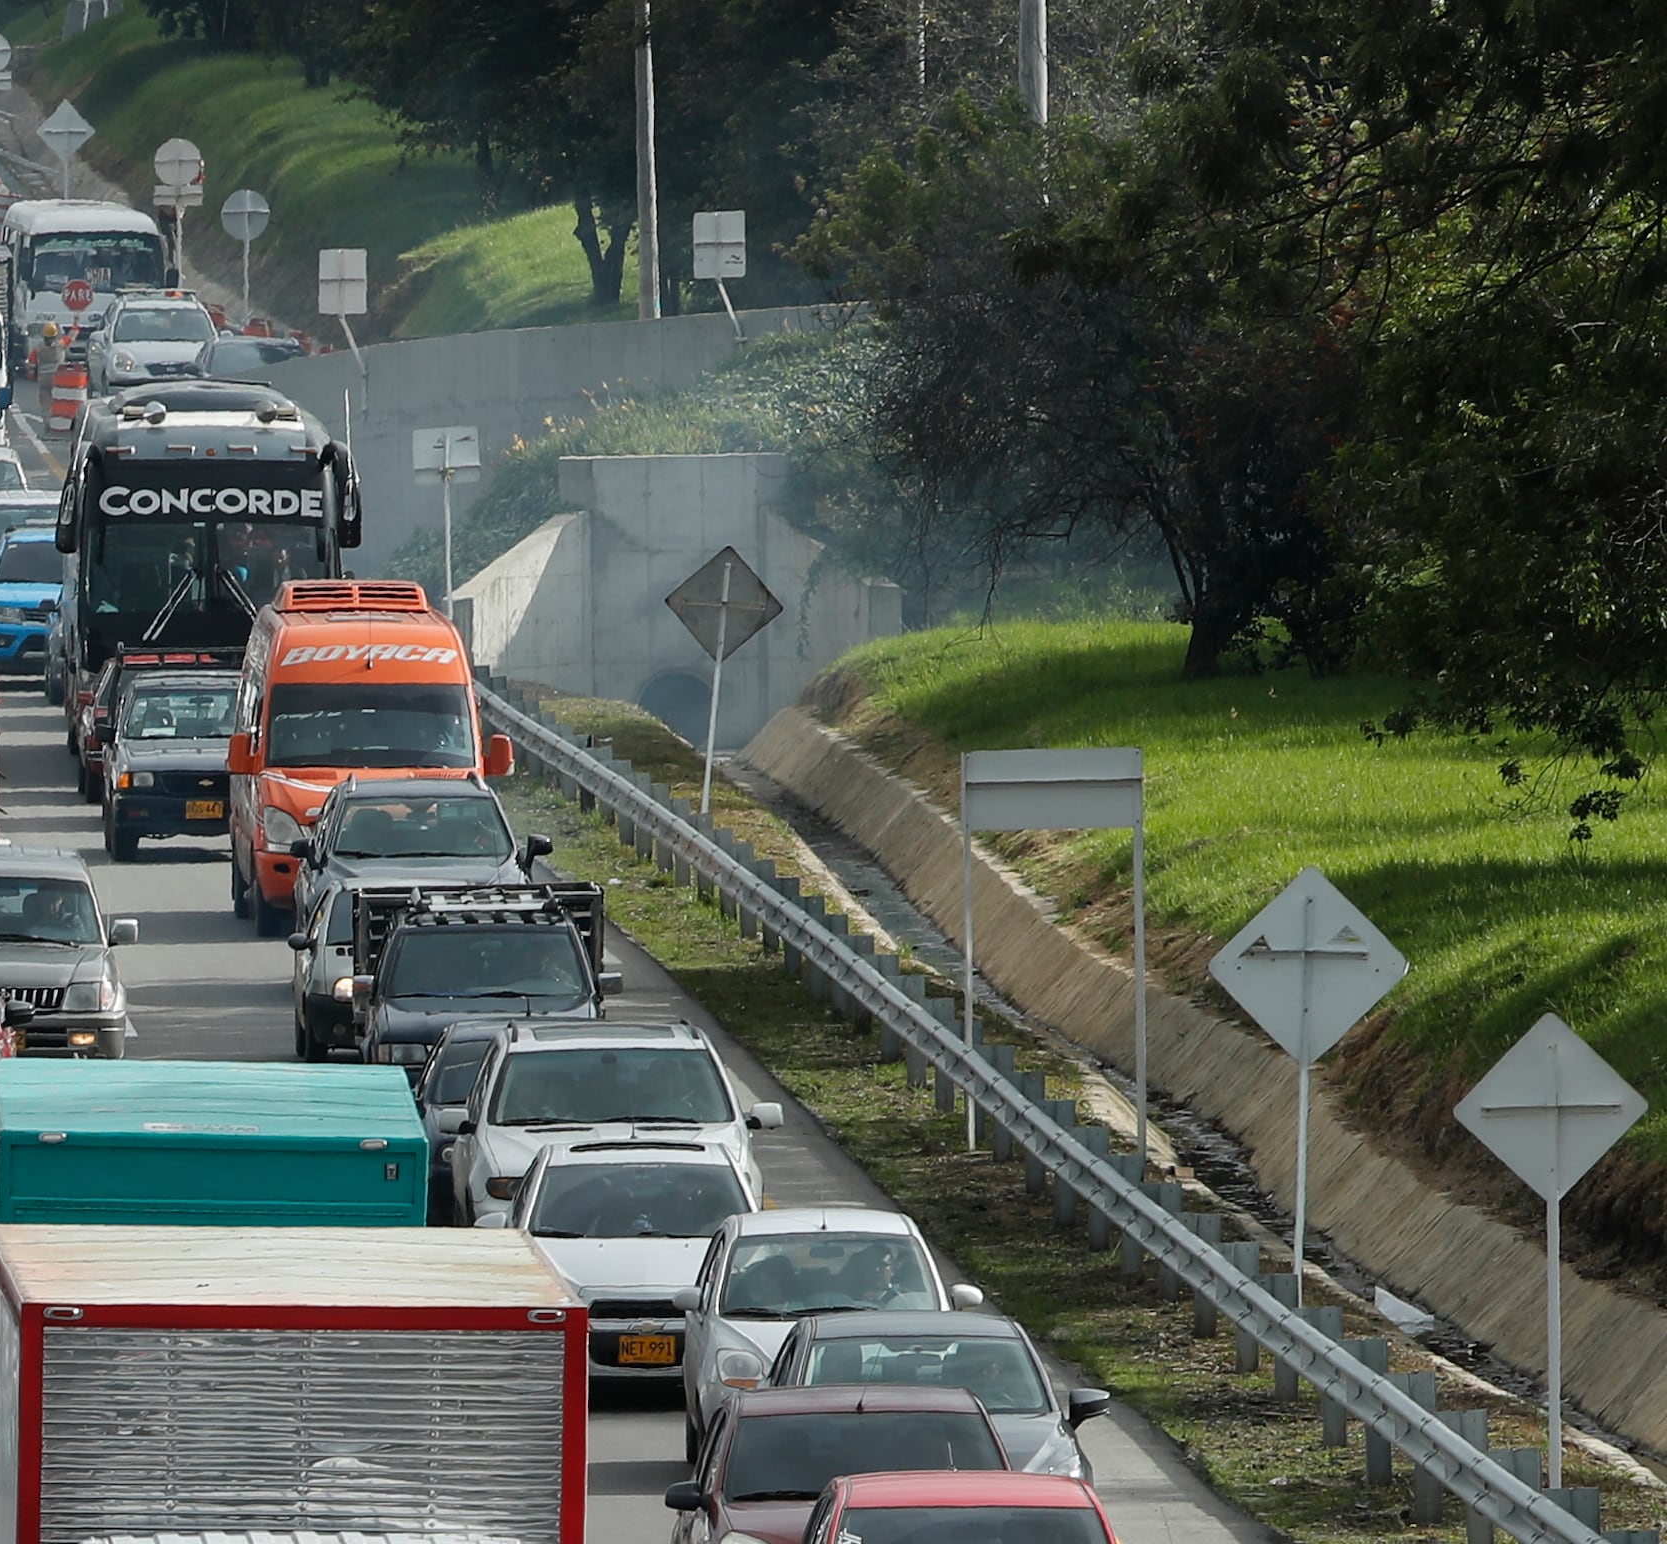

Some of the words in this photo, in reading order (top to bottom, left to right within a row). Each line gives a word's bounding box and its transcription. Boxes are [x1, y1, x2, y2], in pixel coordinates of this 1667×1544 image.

[64, 289, 91, 302] PARE
[99, 485, 324, 518] CONCORDE
[280, 644, 457, 669] BOYACA
[621, 1341, 644, 1356] NET
[648, 1341, 672, 1356] 991
